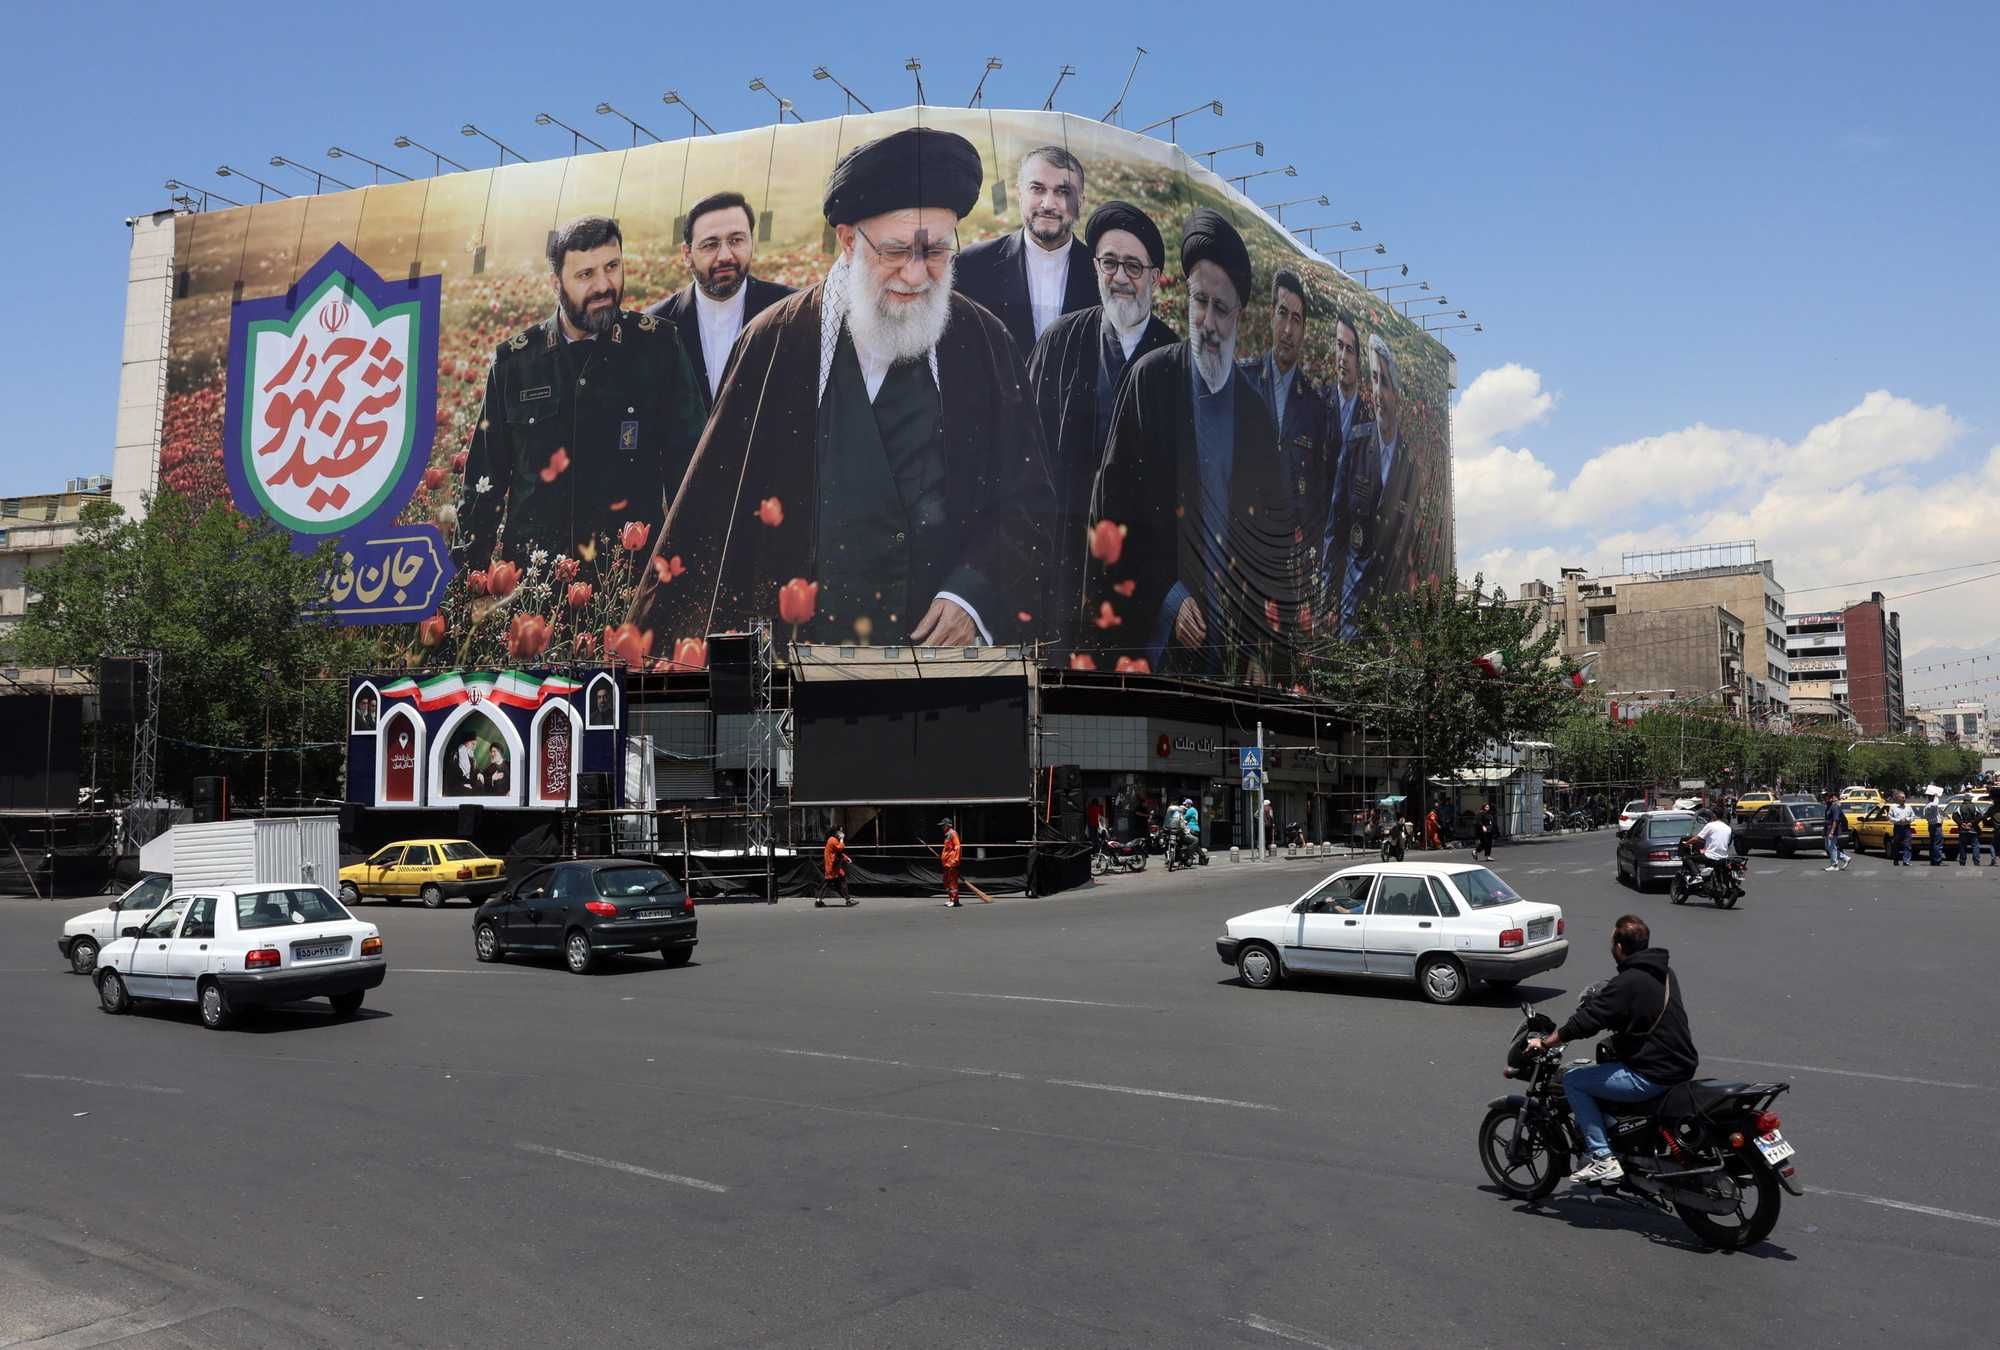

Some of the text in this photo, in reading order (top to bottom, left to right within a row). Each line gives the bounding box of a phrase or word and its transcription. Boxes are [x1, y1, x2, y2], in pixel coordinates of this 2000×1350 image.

[265, 336, 404, 512] شهید
[356, 546, 424, 605] جان
[1175, 735, 1195, 751] ملت
